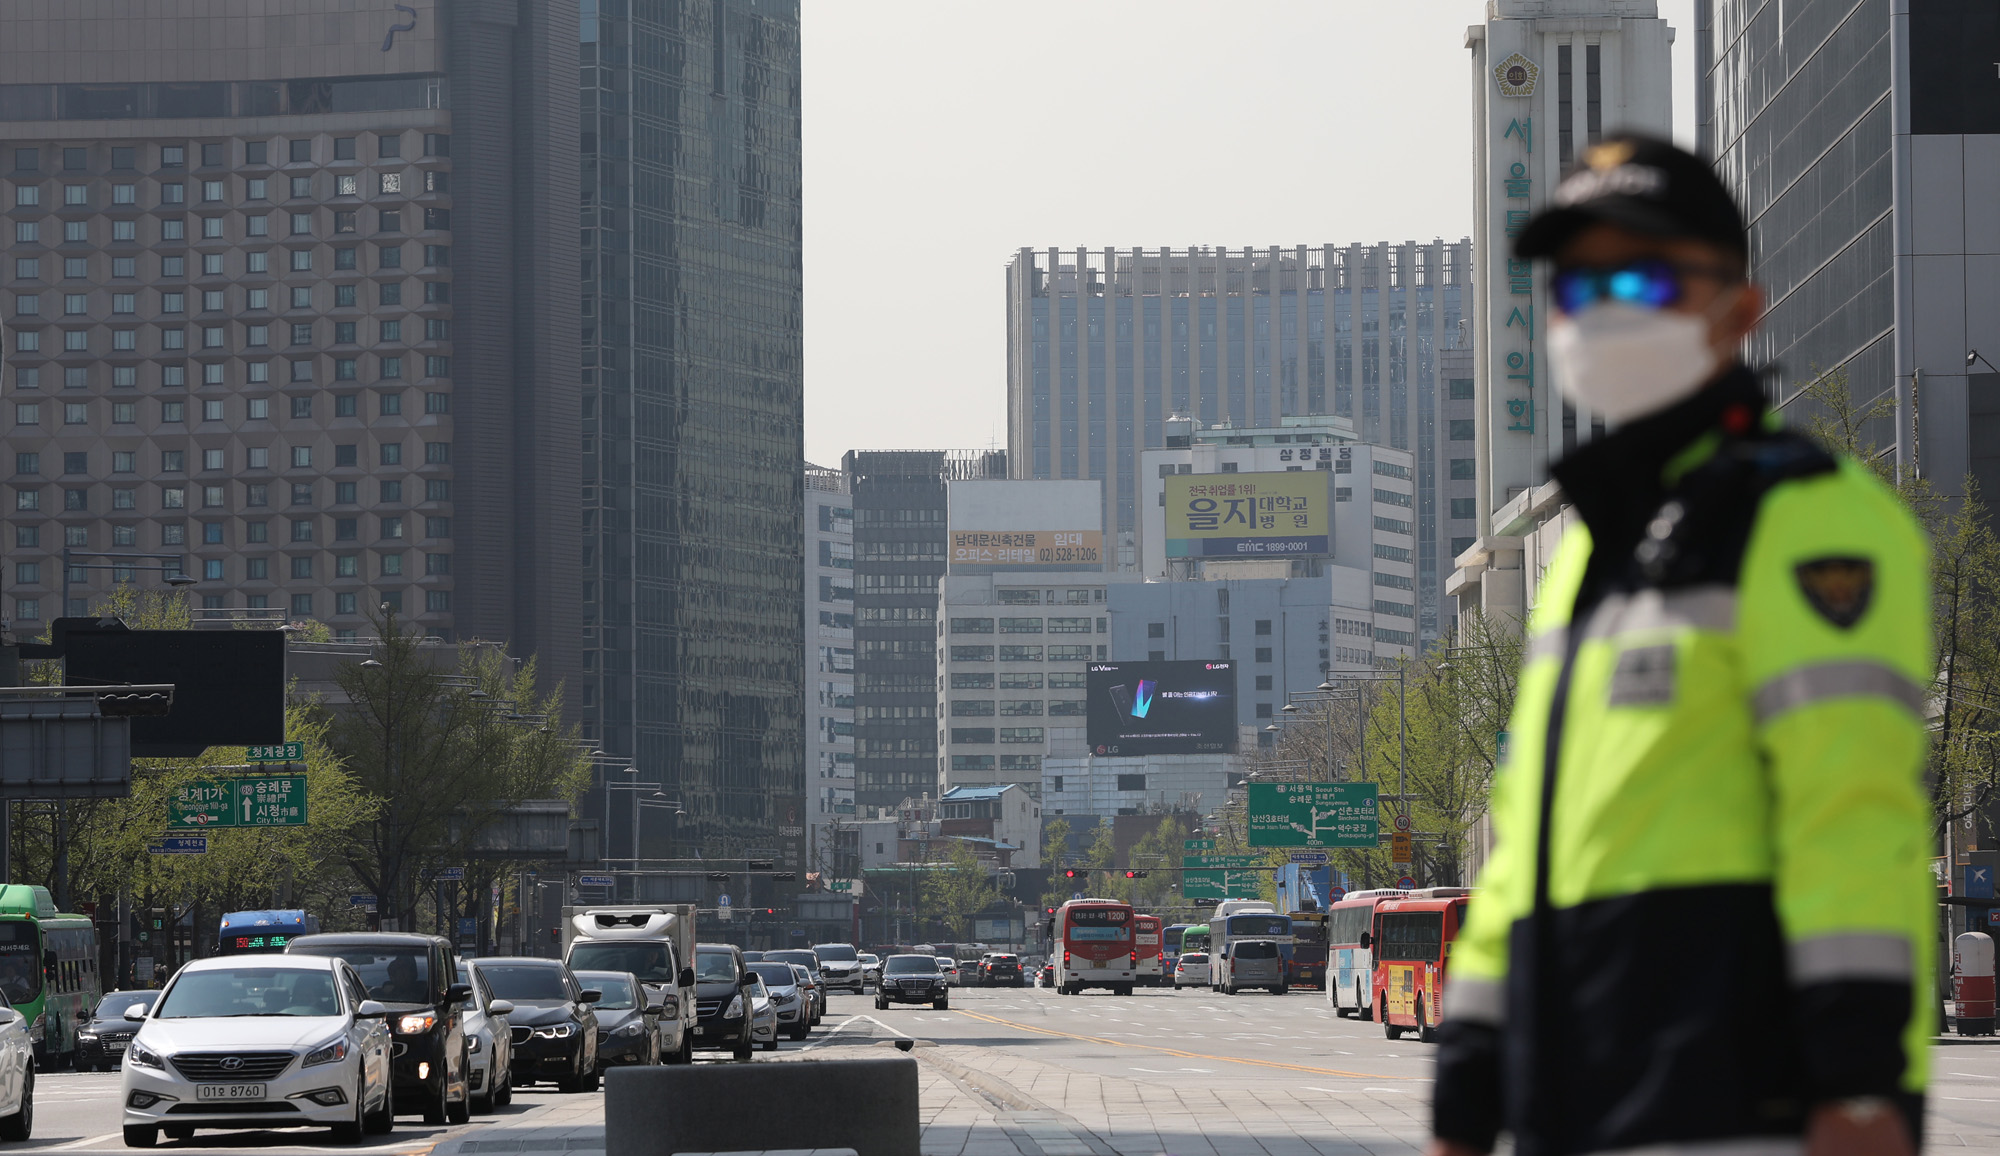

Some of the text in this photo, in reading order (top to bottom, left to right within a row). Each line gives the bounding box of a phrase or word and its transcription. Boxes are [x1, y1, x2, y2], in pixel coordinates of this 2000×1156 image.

[1508, 71, 1526, 81] 의회
[1279, 447, 1352, 462] 삼정빌딩
[1188, 485, 1207, 497] 전국
[1209, 484, 1237, 497] 취업률
[1238, 483, 1256, 495] 1위!
[1259, 495, 1308, 512] 대학교
[1186, 497, 1257, 531] 을지
[1260, 514, 1308, 530] 병원
[955, 533, 1036, 547] 남대문신축건물
[1054, 532, 1083, 547] 임대
[1039, 547, 1097, 563] 02) 528-1206
[252, 745, 297, 758] 청계광장
[1107, 745, 1119, 753] LG
[255, 780, 293, 793] 숭례문
[1288, 785, 1313, 793] 서울역
[1288, 795, 1313, 804] 숭례문
[256, 804, 280, 817] 시청
[1338, 807, 1375, 816] 신촌로터리
[1251, 814, 1290, 823] 남산3호터널
[1398, 819, 1408, 827] 60
[1337, 824, 1367, 833] 덕수궁길
[1107, 912, 1125, 920] 1200
[1268, 926, 1282, 934] 401
[236, 937, 249, 948] 150
[203, 1085, 260, 1098] 01호 8760
